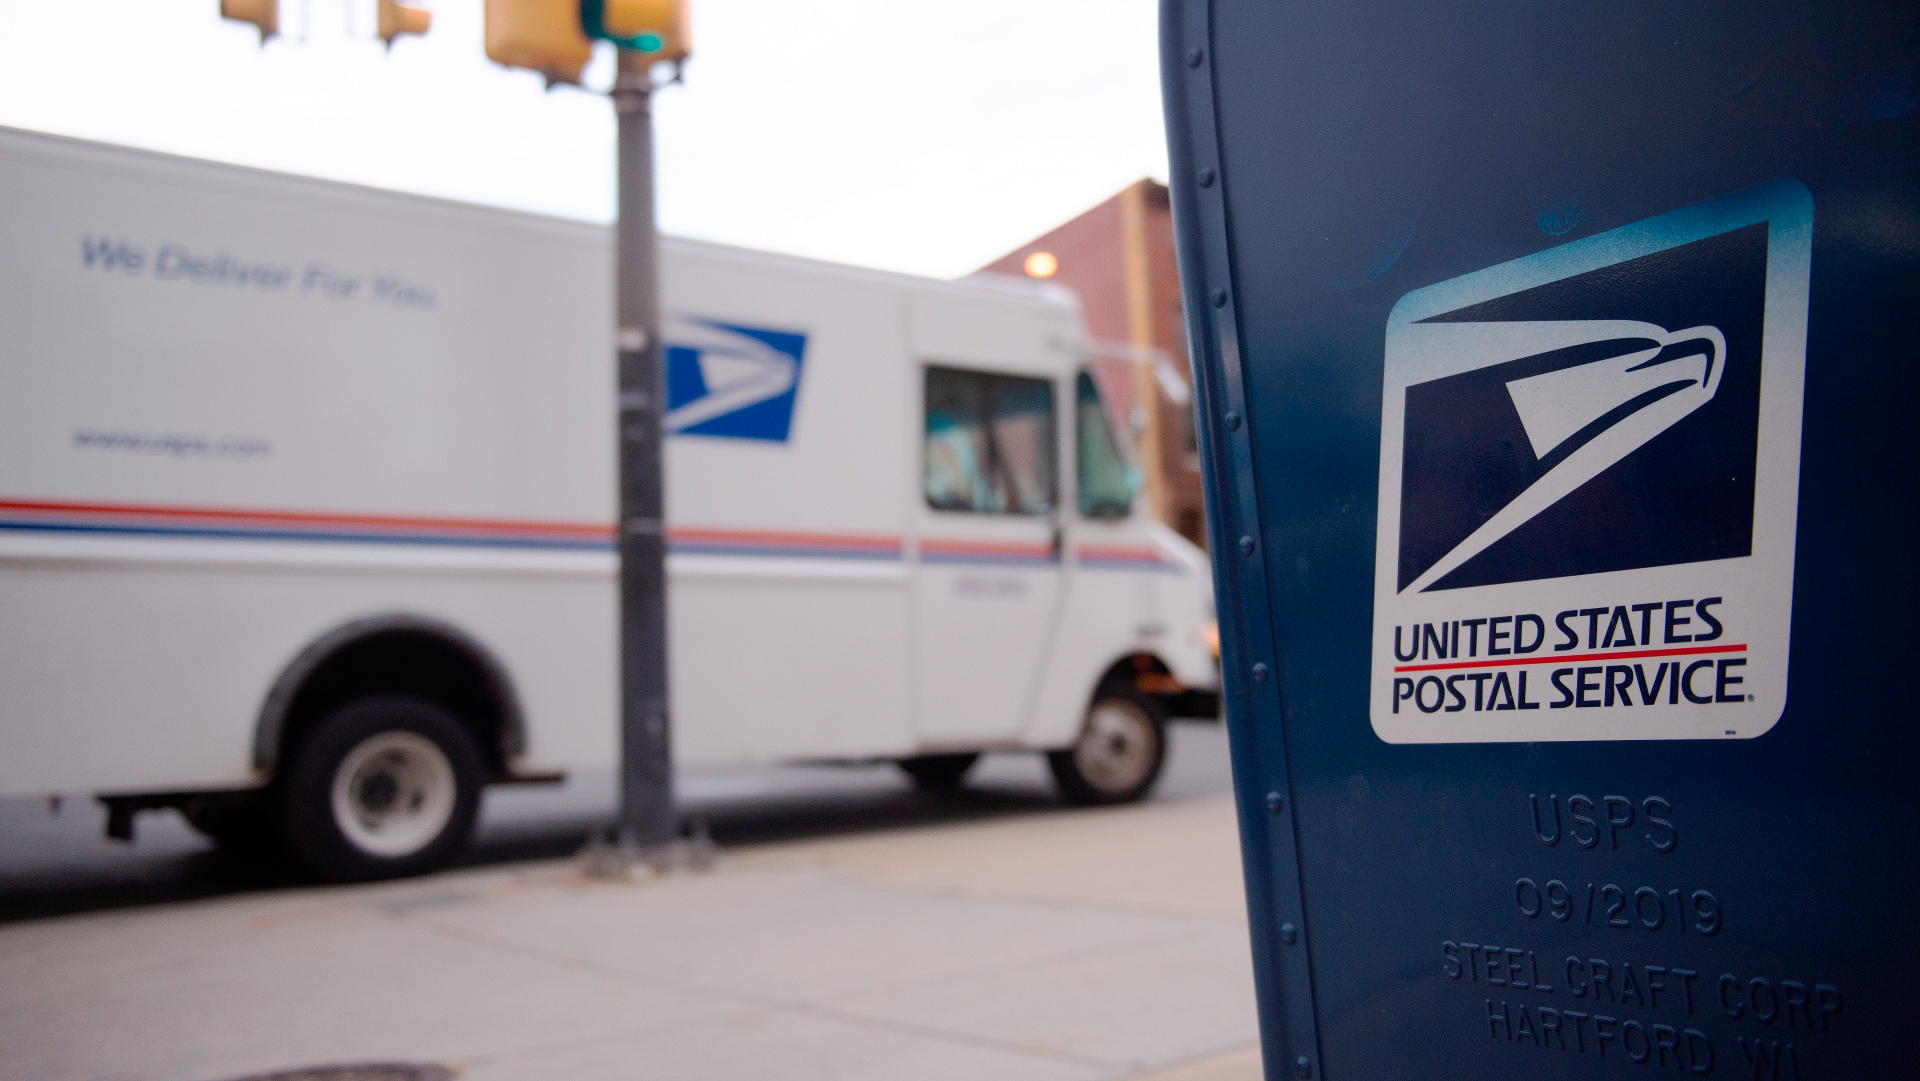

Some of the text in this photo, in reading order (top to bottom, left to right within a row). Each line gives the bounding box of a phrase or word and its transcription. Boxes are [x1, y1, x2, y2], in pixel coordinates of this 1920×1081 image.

[81, 233, 146, 276] We
[154, 242, 293, 293] Deliver
[300, 260, 361, 302] For
[1394, 596, 1724, 663] UNITED STATES
[1392, 670, 1540, 714] POSTAL
[1529, 794, 1678, 853] USPS
[1442, 940, 1845, 1032] STEEL CRAFT CORP
[1485, 999, 1799, 1081] HARTFORD WI
